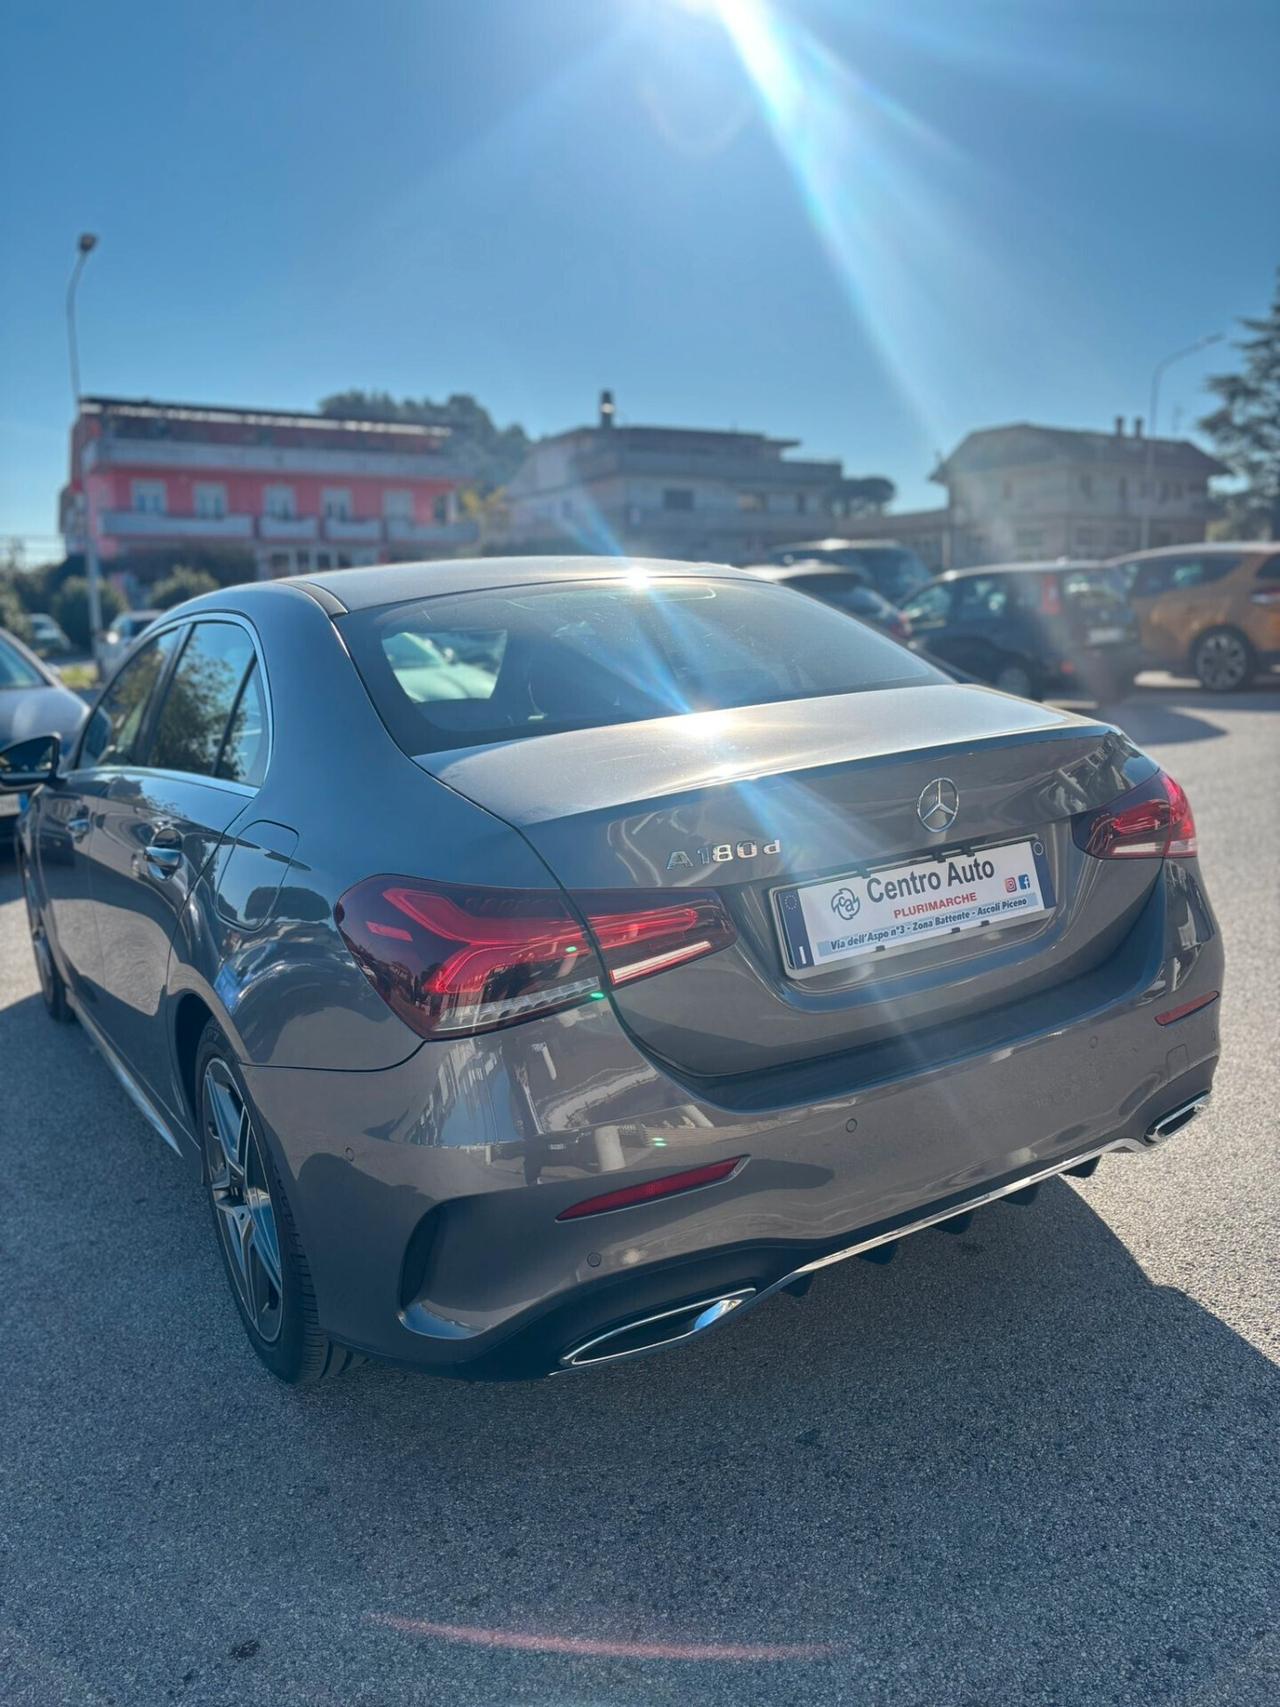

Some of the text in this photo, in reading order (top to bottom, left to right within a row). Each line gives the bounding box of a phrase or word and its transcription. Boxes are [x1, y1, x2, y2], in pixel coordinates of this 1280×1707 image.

[866, 858, 995, 903] Centro Auto
[830, 940, 846, 950] Via
[913, 921, 933, 931] Zona
[935, 911, 970, 926] Battente
[977, 904, 1001, 916] Ascoli
[1002, 898, 1027, 910] Piceno
[893, 892, 977, 919] PLURIMARCHE
